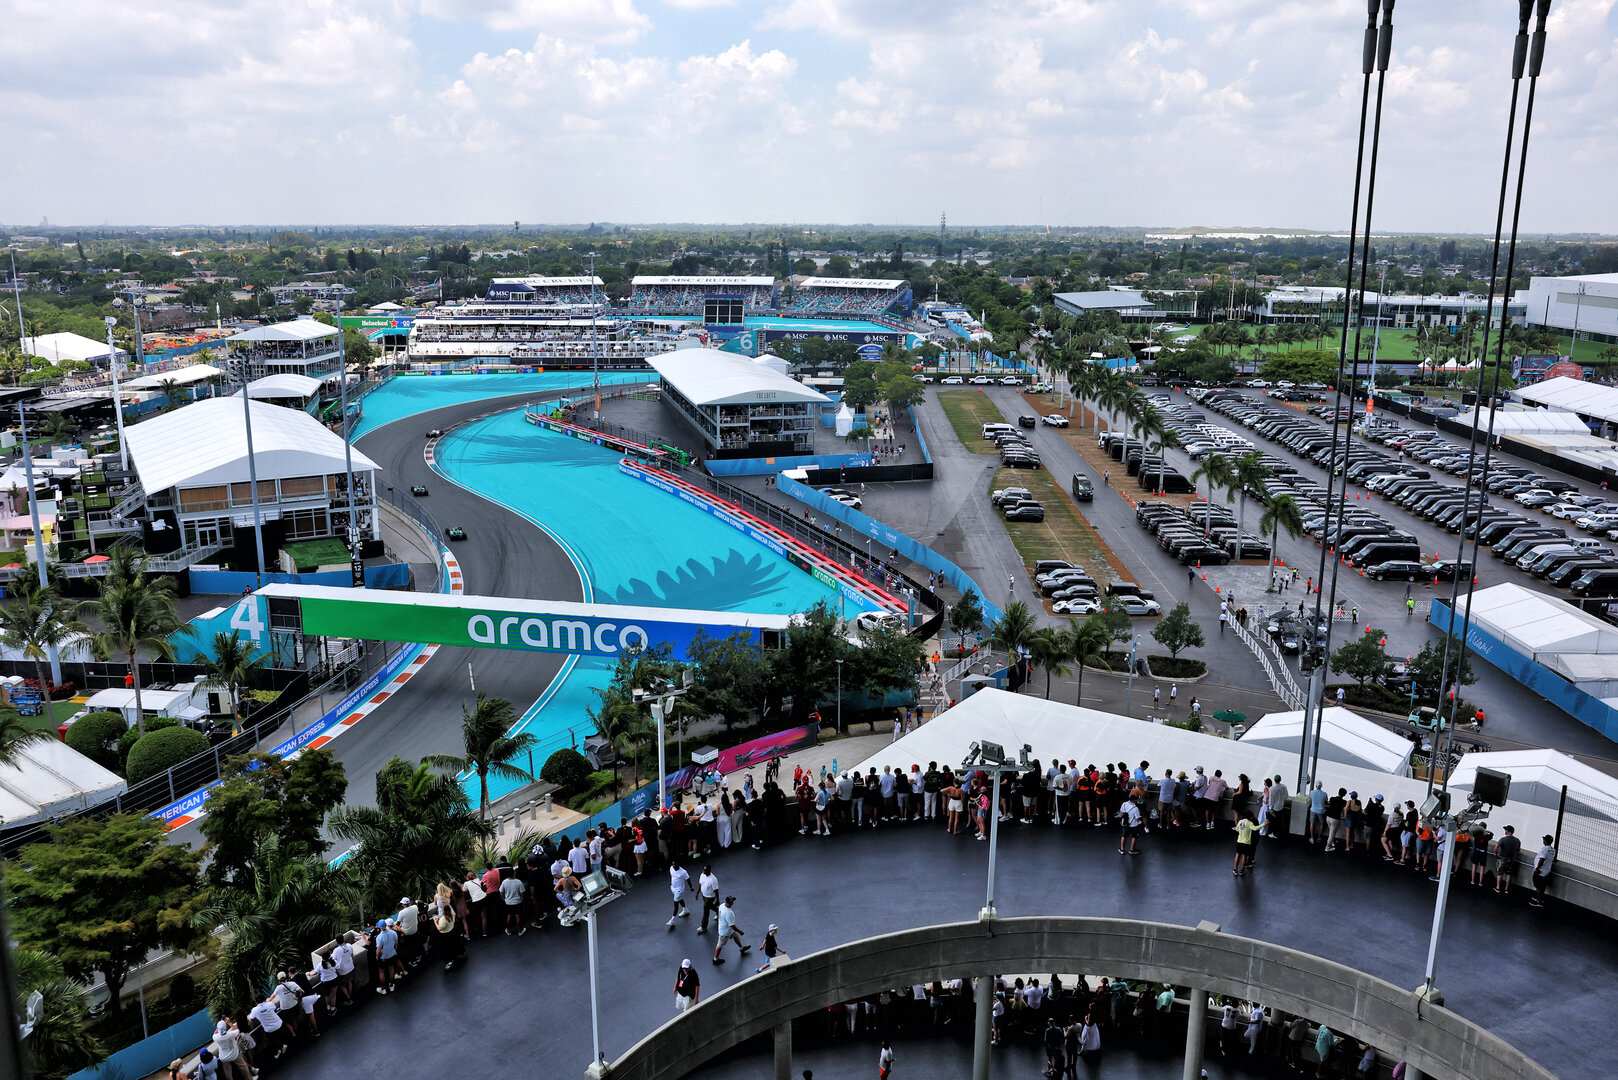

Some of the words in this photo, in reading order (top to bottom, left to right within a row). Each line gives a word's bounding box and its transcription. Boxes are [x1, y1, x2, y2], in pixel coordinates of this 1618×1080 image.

[740, 333, 753, 350] 6
[832, 334, 849, 342] MSC
[713, 509, 730, 523] AMERICAN
[729, 518, 745, 532] EXPRESS
[750, 530, 768, 545] AMERICAN
[768, 540, 784, 555] EXPRESS
[814, 569, 836, 588] aramco
[841, 585, 864, 606] aramco
[230, 595, 265, 640] 4
[467, 614, 649, 655] aramco
[335, 693, 360, 718] AMERICAN
[360, 676, 379, 698] EXPRESS
[297, 720, 326, 745] EXPRESS
[156, 795, 200, 819] MERICAN
